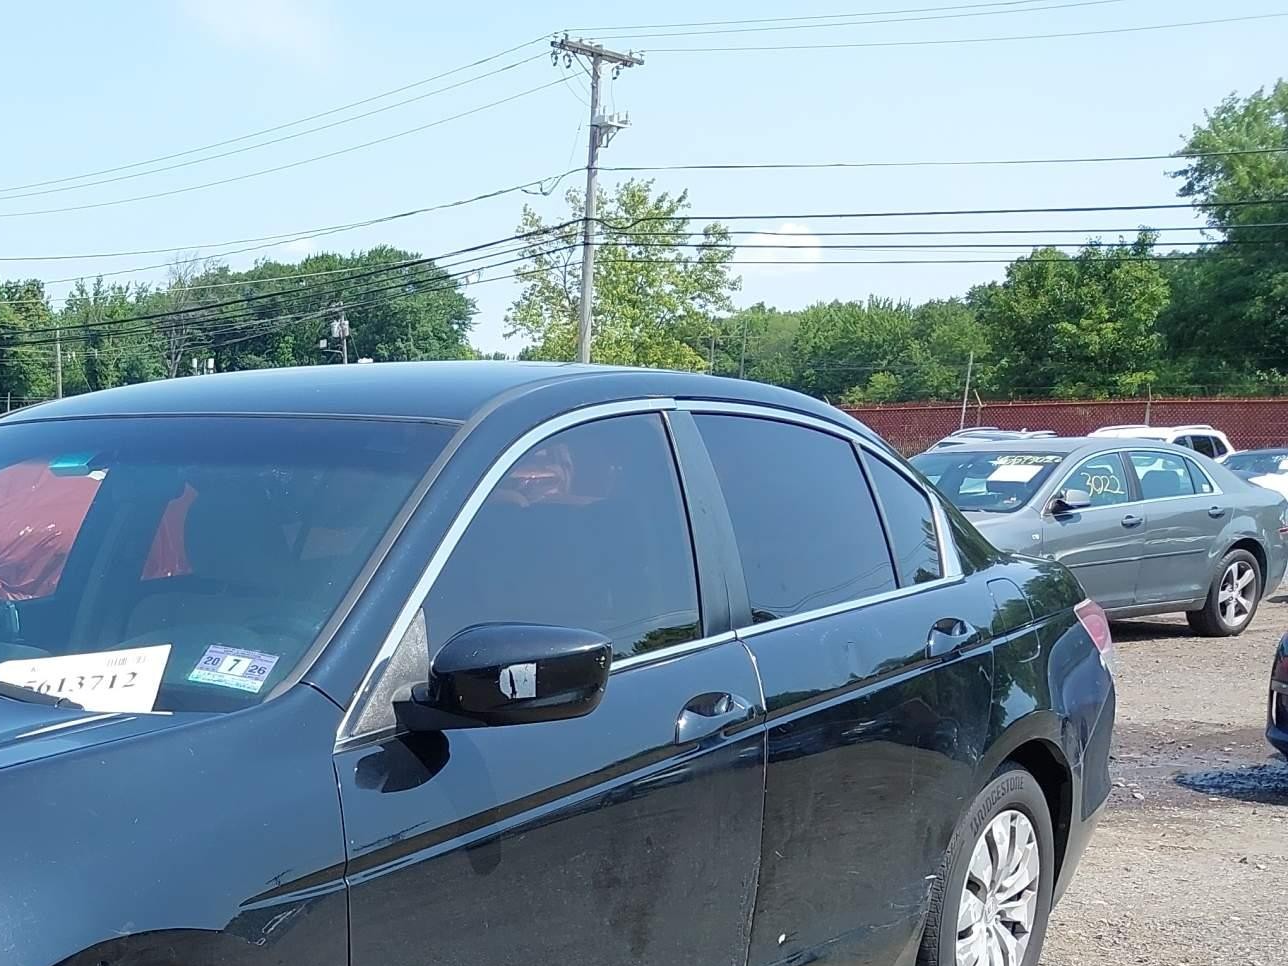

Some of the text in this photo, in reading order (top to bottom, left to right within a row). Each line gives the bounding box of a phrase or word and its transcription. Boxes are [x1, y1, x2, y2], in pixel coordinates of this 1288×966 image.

[1081, 472, 1126, 497] 3022
[204, 656, 267, 675] 20 7 26
[970, 775, 1024, 838] BRIDGESTONE
